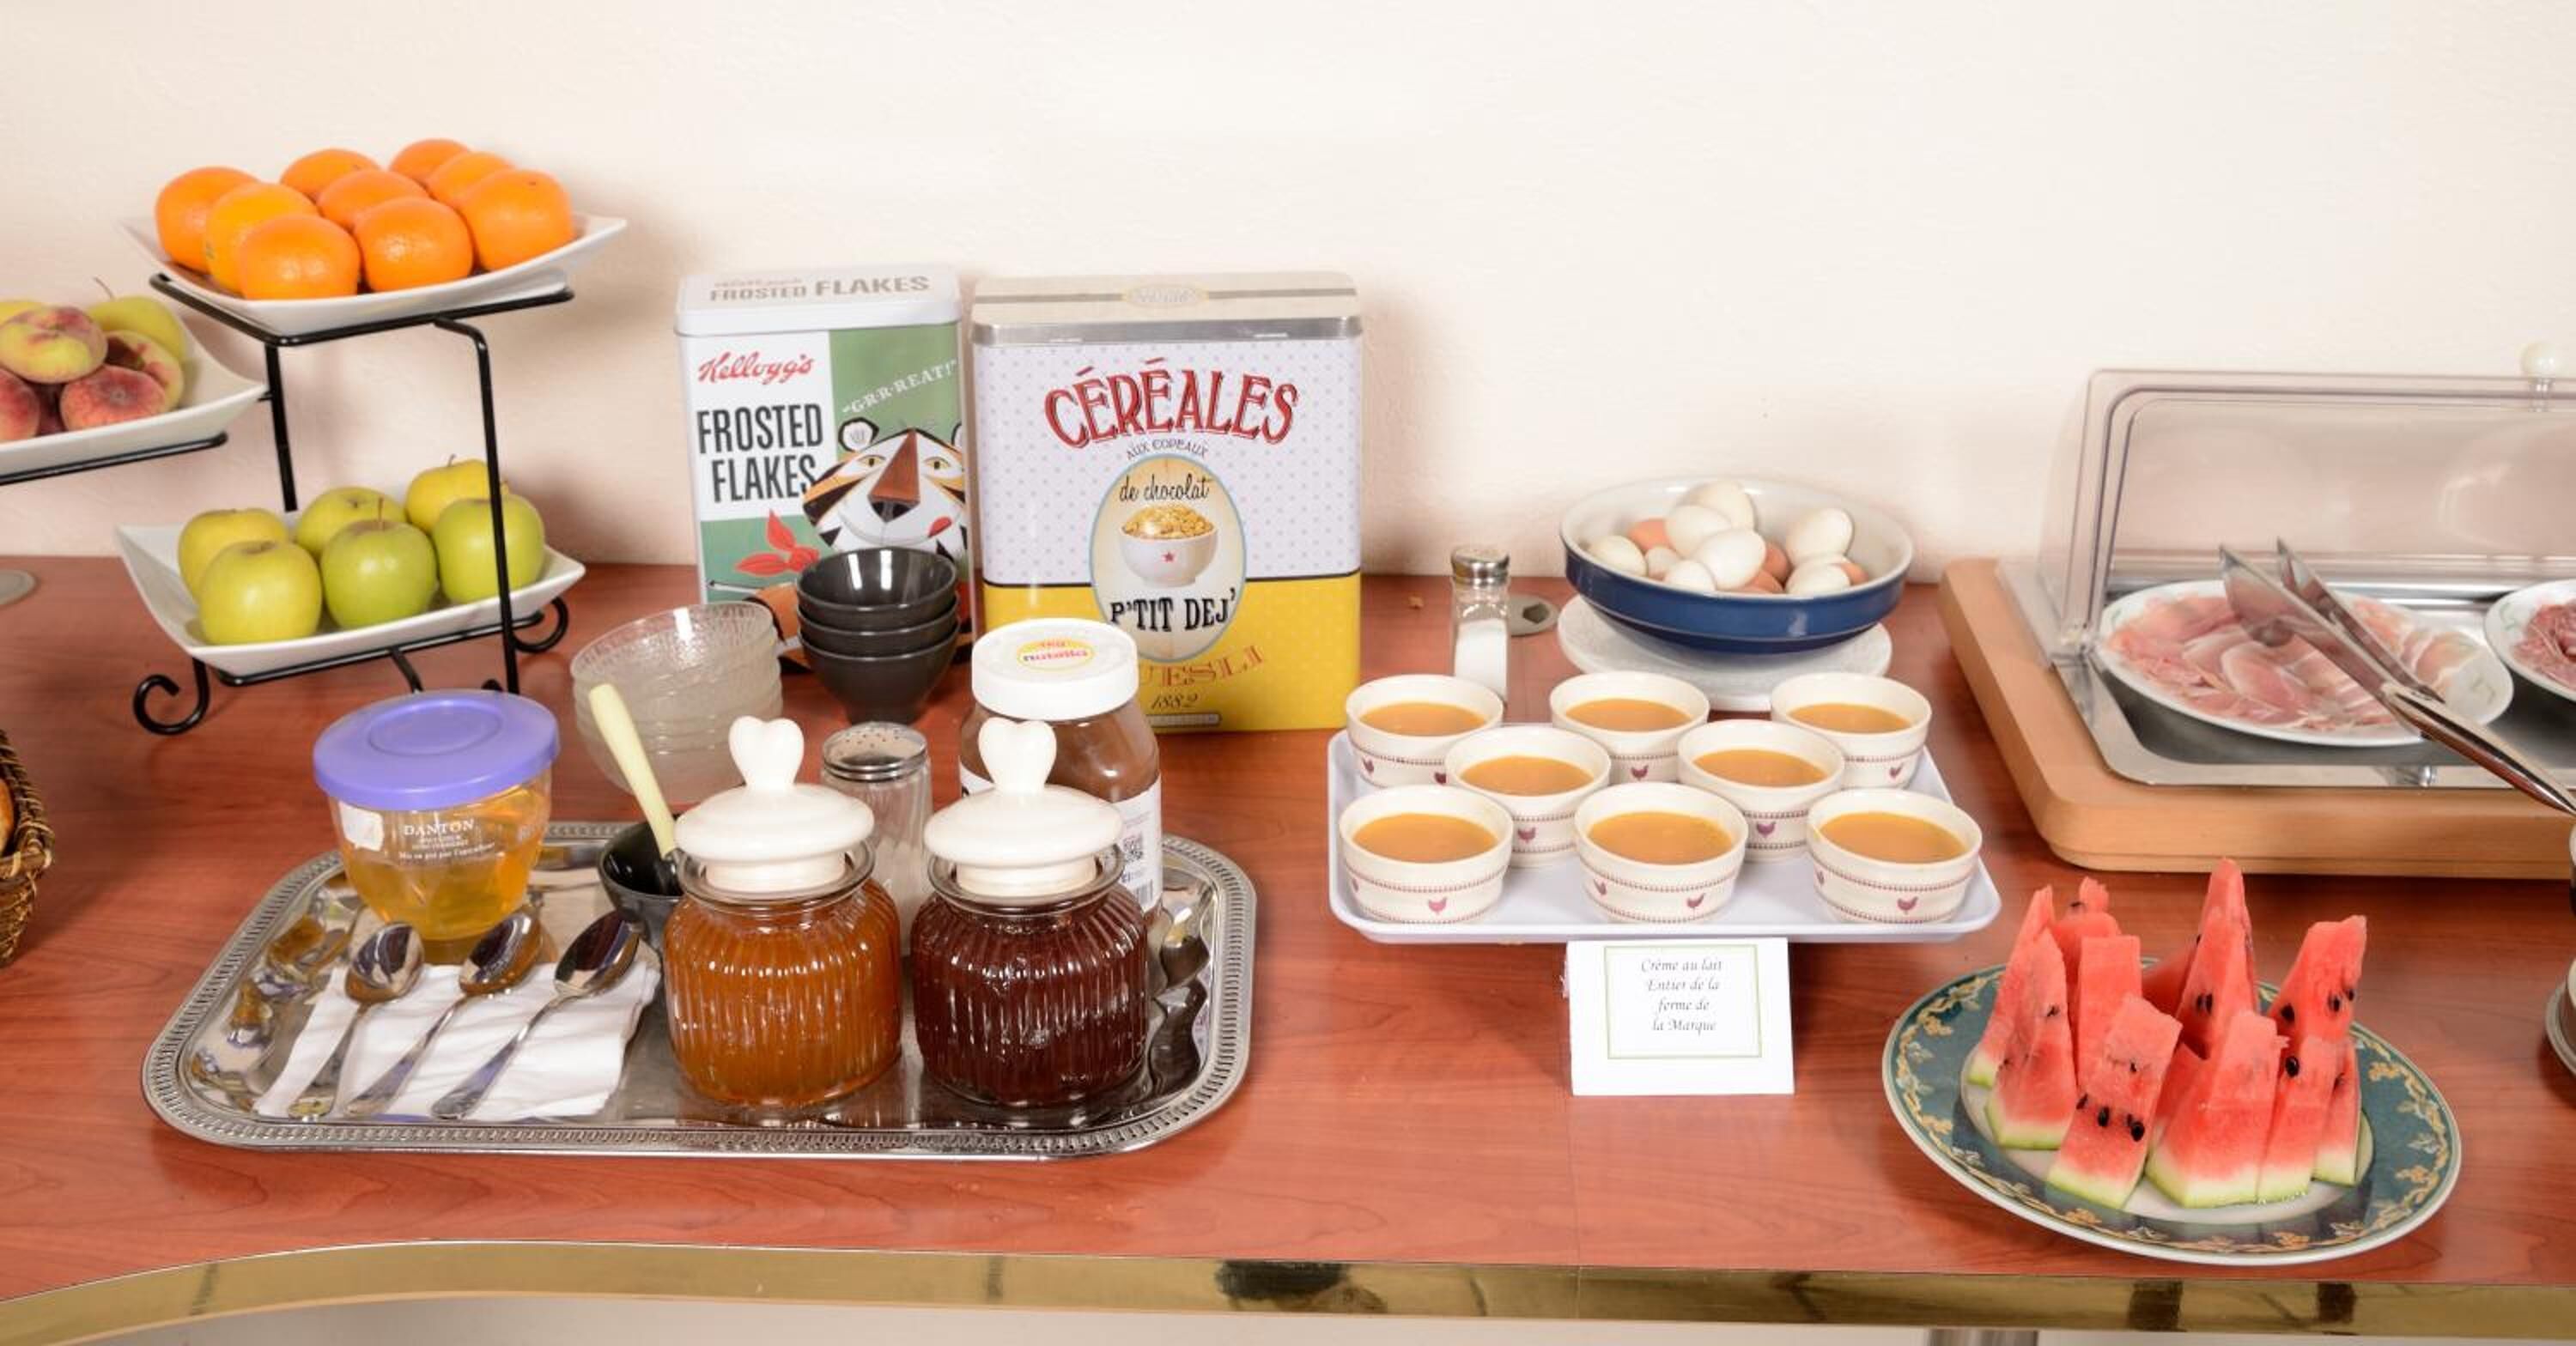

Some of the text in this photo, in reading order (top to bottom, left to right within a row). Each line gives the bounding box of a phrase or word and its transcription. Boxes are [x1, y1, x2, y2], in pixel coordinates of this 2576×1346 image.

[710, 286, 807, 301] FROSTED
[815, 275, 931, 297] FLAKES
[697, 350, 815, 385] Kellogg's
[1043, 356, 1299, 449] CÉRÉALES
[696, 403, 823, 454] FROSTED
[1127, 439, 1209, 460] AUX COPEAUX
[711, 454, 817, 504] FLAKES
[1119, 471, 1213, 503] de chocolat
[1110, 597, 1175, 633] P'TIT
[1139, 645, 1265, 688] ESLI
[404, 818, 475, 837] DANTON
[1641, 955, 1722, 973] Crème au lait
[1648, 975, 1720, 991] Entier de la
[1657, 996, 1710, 1014] ferme de
[1652, 1015, 1716, 1037] la Marque
